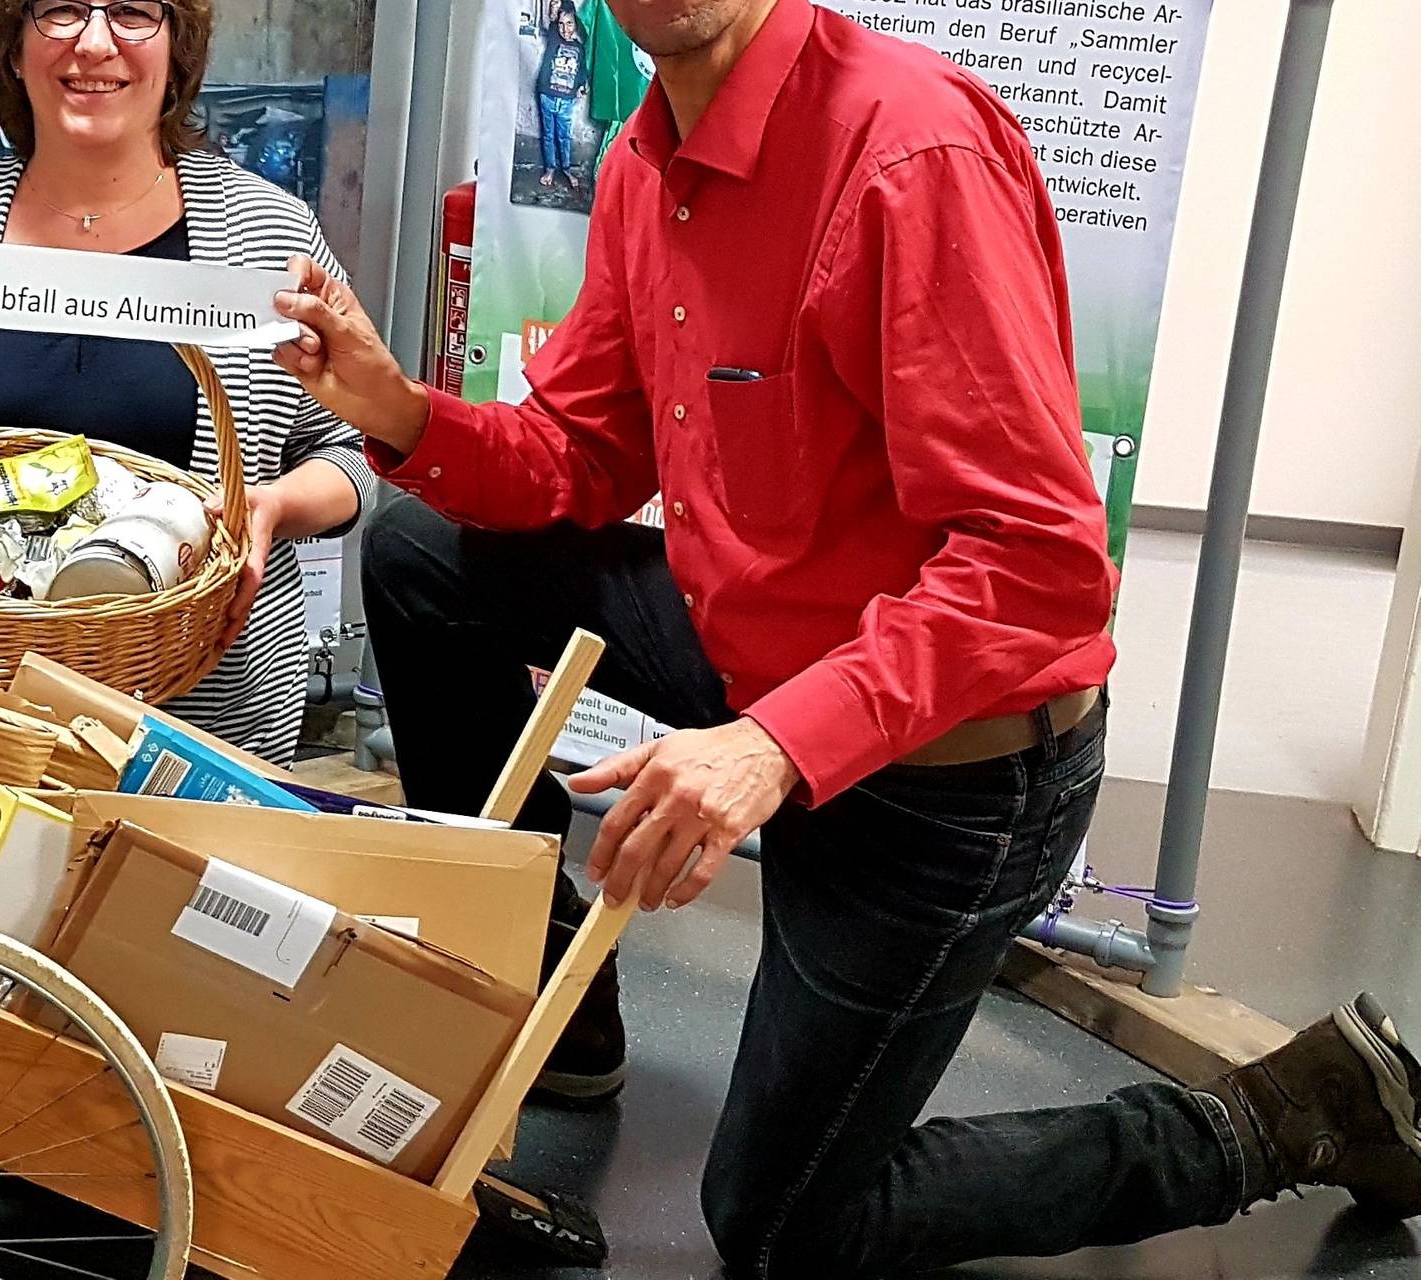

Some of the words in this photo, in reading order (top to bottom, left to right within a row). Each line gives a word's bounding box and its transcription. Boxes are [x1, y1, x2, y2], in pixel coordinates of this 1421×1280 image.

[1153, 5, 1183, 23] Ar-
[949, 19, 986, 39] den
[1000, 22, 1058, 44] Beruf
[1069, 29, 1178, 54] „Sammler
[1038, 58, 1077, 75] und
[1091, 63, 1173, 84] recycel-
[1104, 90, 1167, 114] Damit
[1016, 114, 1120, 139] eschützte
[1134, 124, 1163, 142] Ar-
[1053, 146, 1093, 166] sich
[1100, 150, 1157, 172] diese
[65, 297, 108, 317] aus
[116, 296, 256, 329] Aluminium
[605, 703, 627, 716] und
